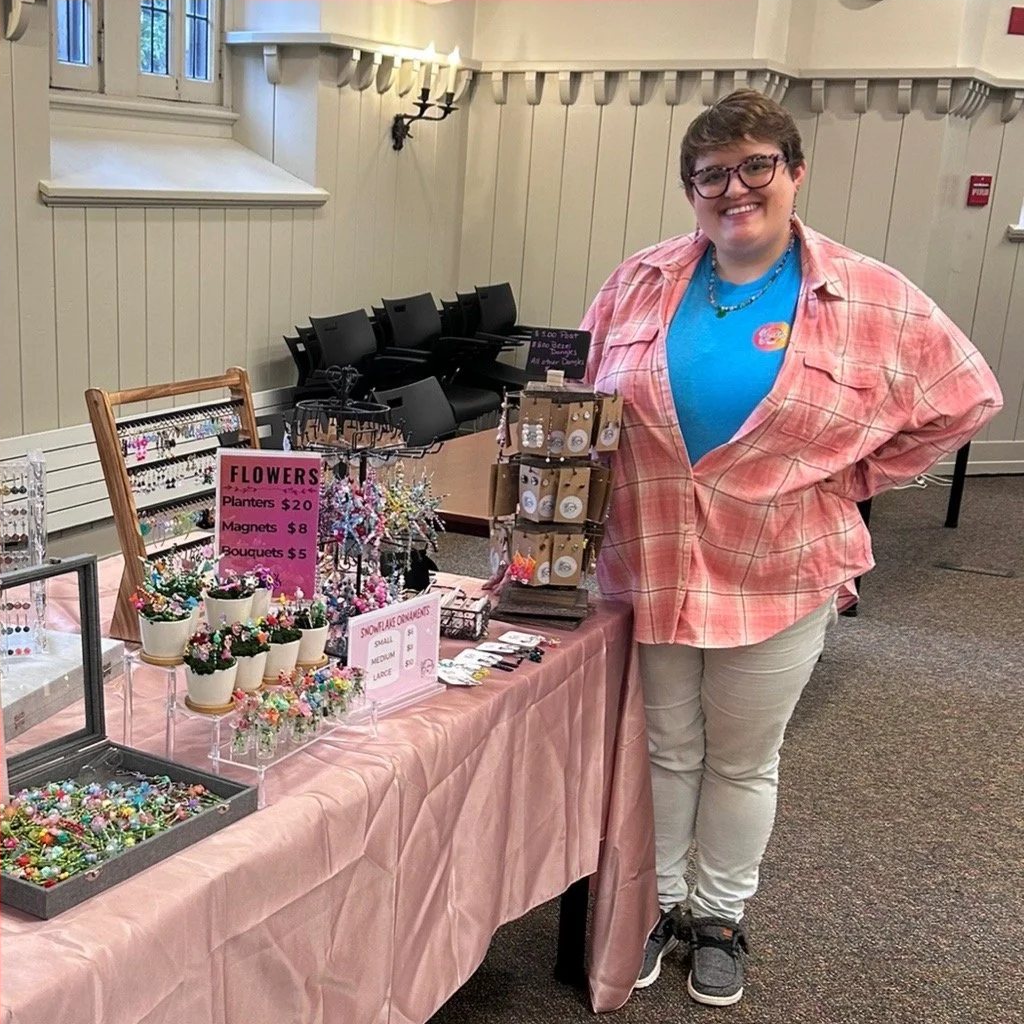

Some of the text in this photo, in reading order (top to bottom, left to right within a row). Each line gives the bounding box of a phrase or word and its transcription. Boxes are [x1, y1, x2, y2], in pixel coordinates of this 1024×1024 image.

[230, 465, 319, 486] FLOWERS
[222, 495, 313, 512] Planters $20
[222, 521, 308, 535] Magnets $8
[221, 545, 307, 560] Bouquets $5
[360, 605, 431, 639] SNOWFLAKE ORNAMENTS
[374, 636, 393, 648] SMALL
[371, 651, 396, 665] MEDIUM
[372, 668, 393, 681] LARGE
